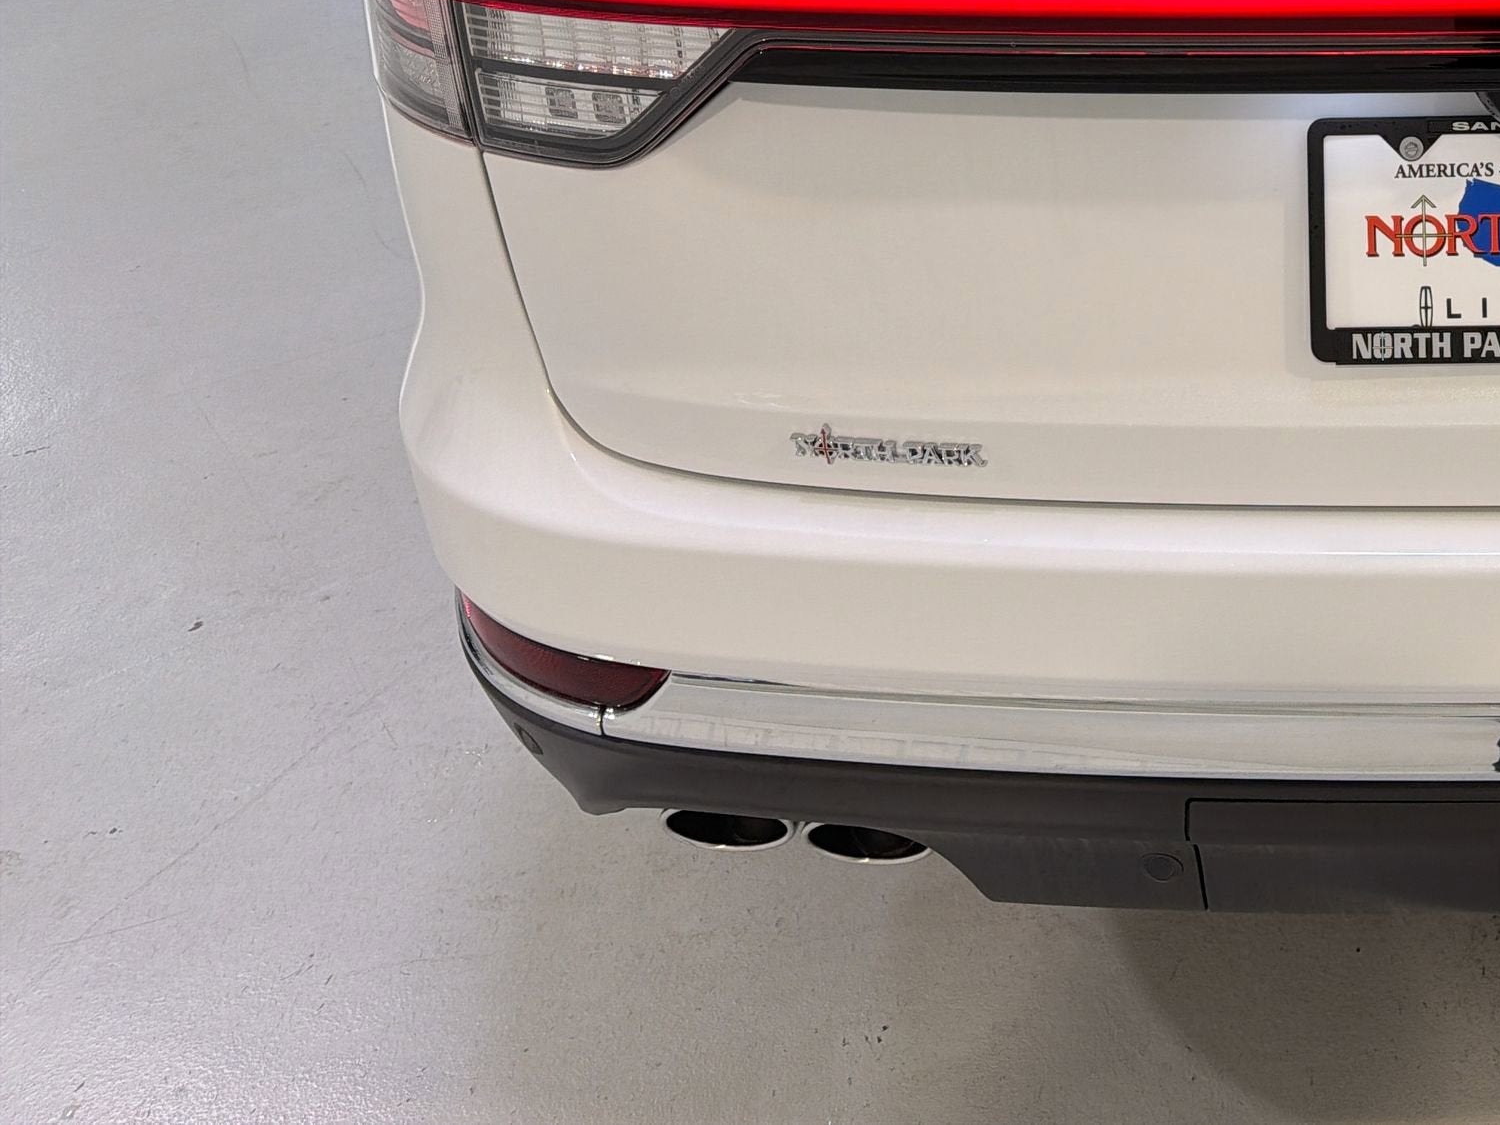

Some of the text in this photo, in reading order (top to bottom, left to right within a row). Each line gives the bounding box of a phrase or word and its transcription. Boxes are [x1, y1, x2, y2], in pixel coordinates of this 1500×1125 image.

[1394, 160, 1495, 179] AMERICA'S
[1352, 331, 1452, 360] NORTH
[790, 432, 989, 468] NORTH PARK
